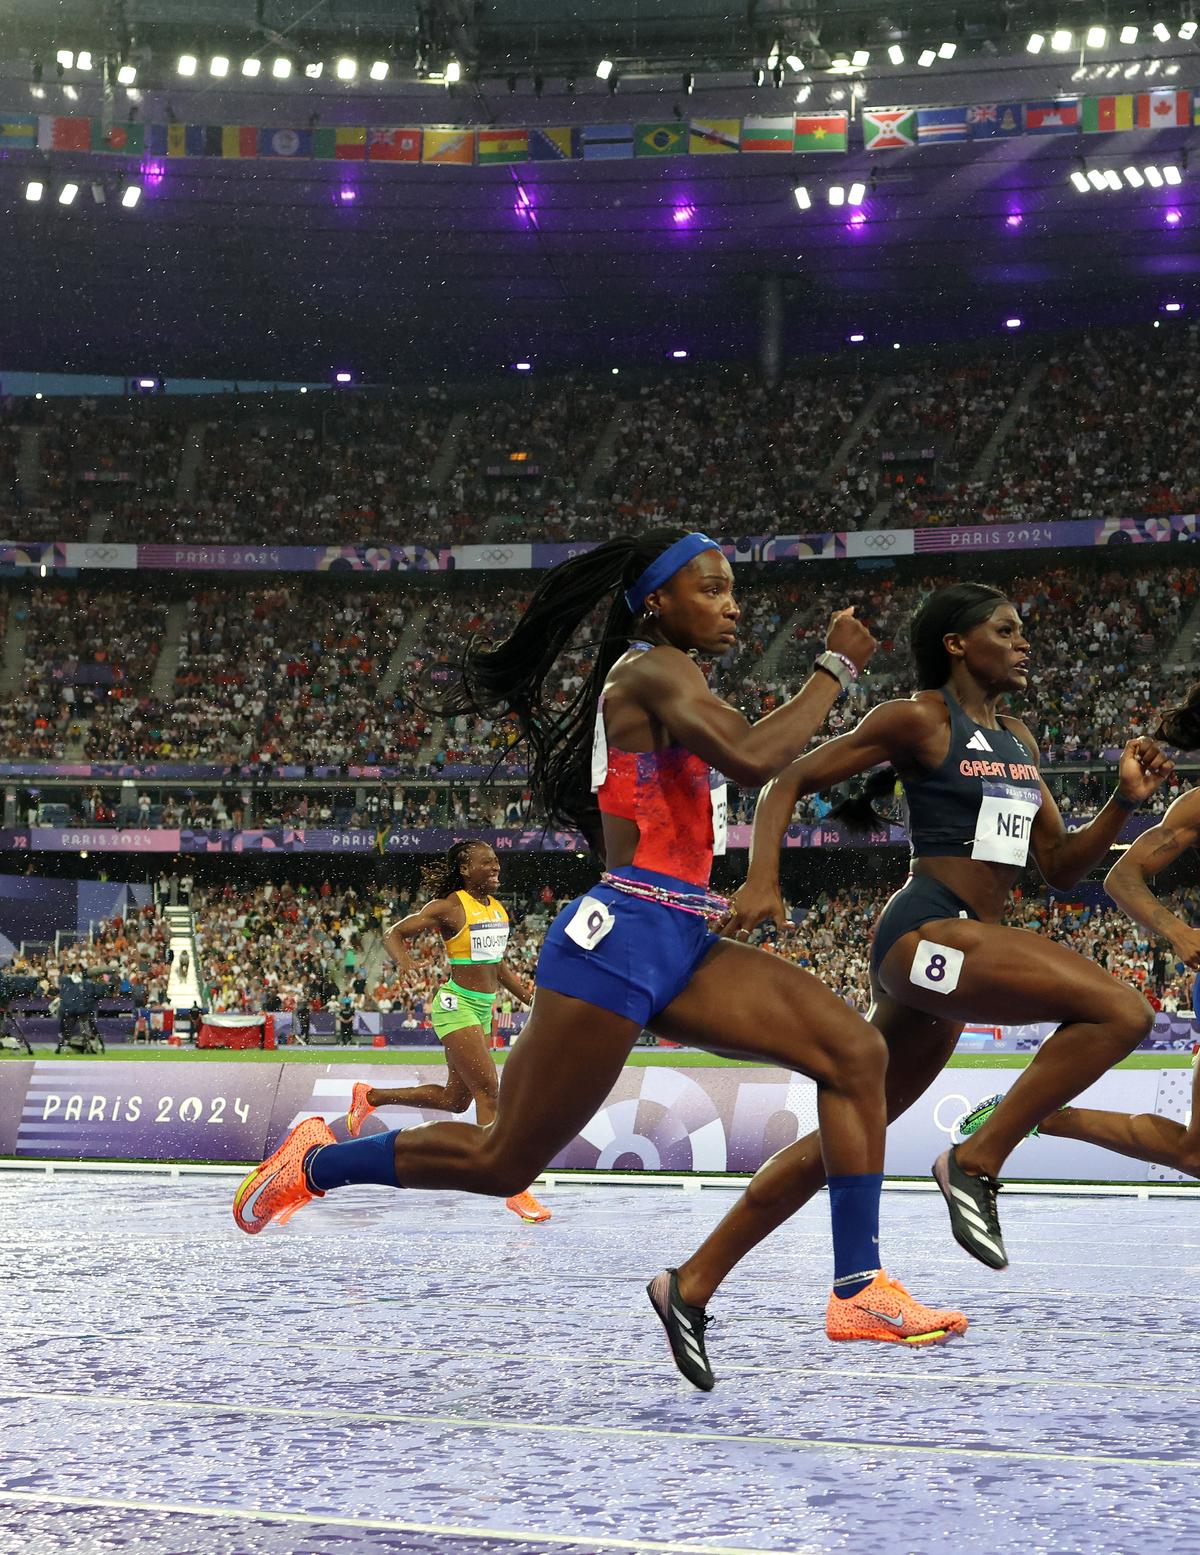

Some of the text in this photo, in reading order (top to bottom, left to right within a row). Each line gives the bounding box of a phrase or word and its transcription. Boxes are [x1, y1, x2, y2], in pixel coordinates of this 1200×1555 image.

[1007, 529, 1052, 543] 2024
[233, 552, 279, 564] 2024
[960, 760, 1007, 778] GREAT
[112, 834, 151, 845] 2024
[390, 835, 420, 845] 024
[823, 832, 840, 843] H3
[586, 910, 601, 940] 9
[472, 937, 481, 949] TA
[925, 953, 946, 982] 8
[445, 997, 452, 1009] 3
[155, 1096, 250, 1123] 2024
